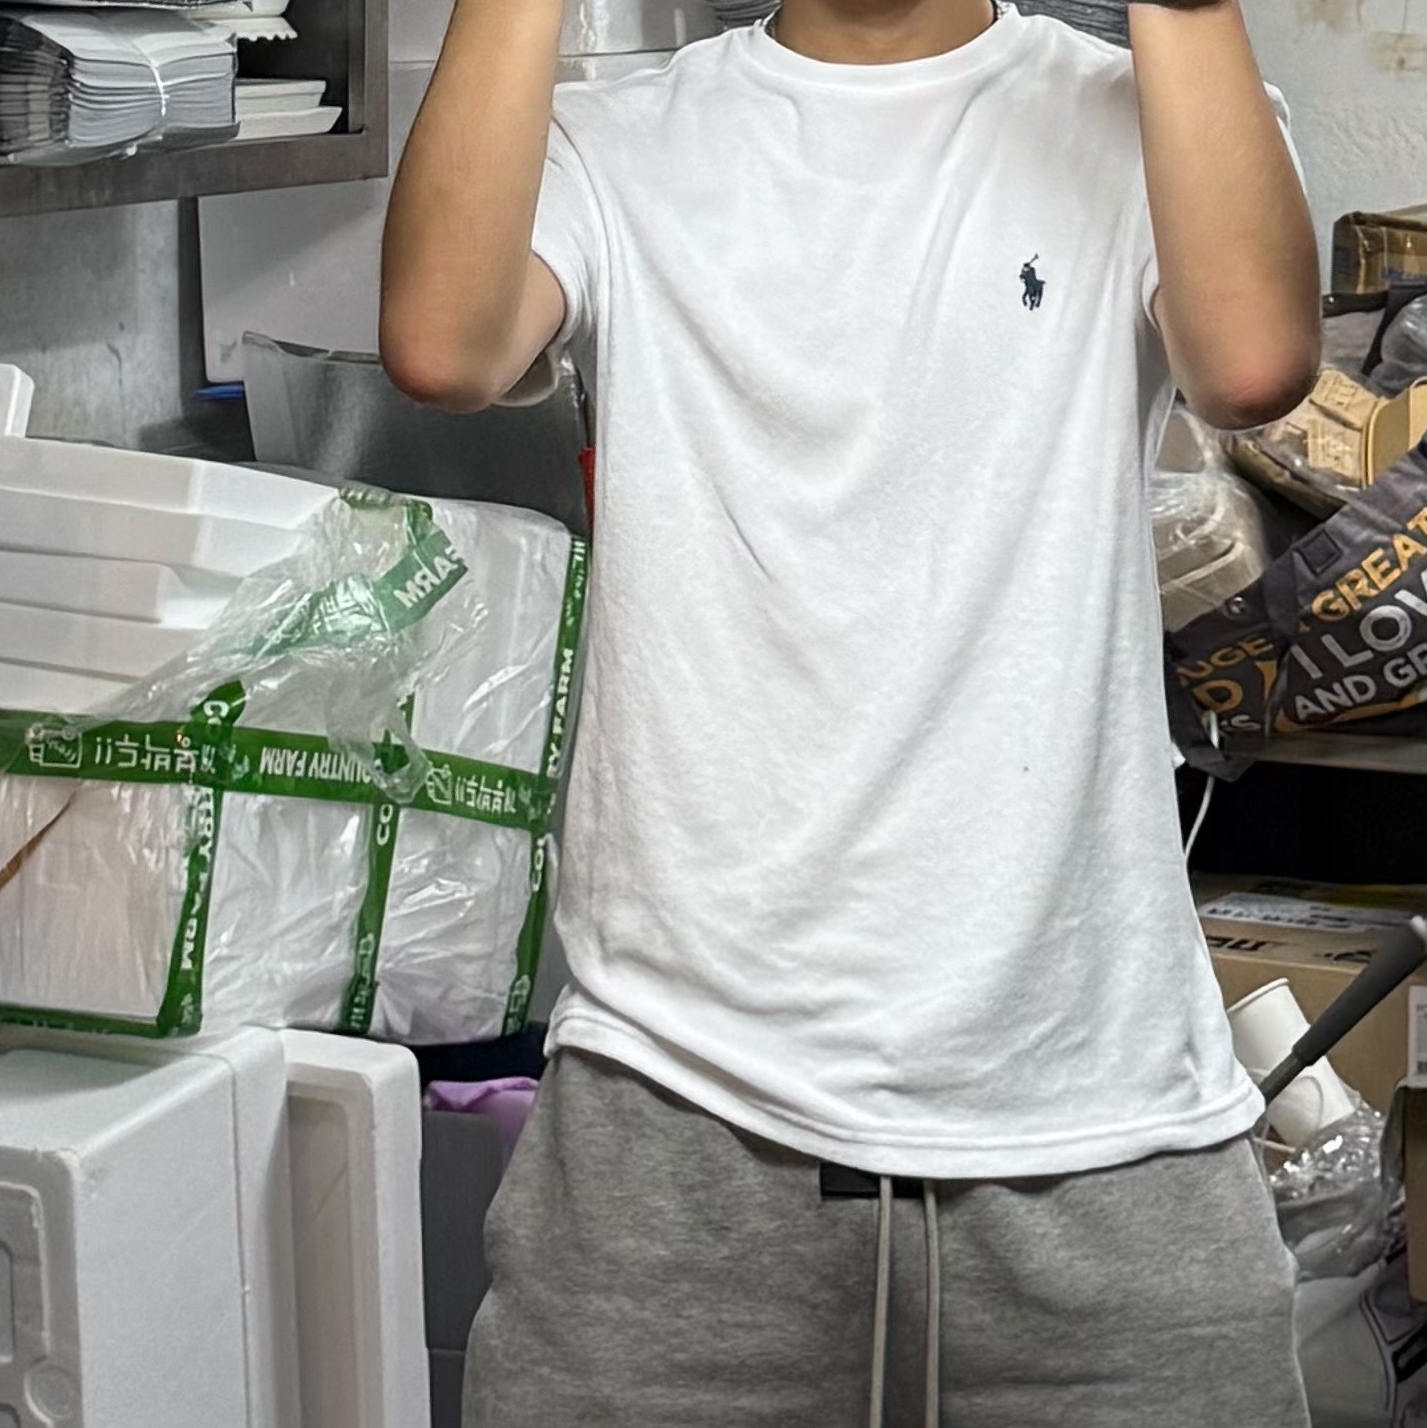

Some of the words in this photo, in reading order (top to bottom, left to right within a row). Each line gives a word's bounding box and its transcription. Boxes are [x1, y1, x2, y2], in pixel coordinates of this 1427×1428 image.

[1290, 644, 1322, 679] I
[1294, 674, 1377, 721] AND
[308, 750, 372, 785] OUNTRY
